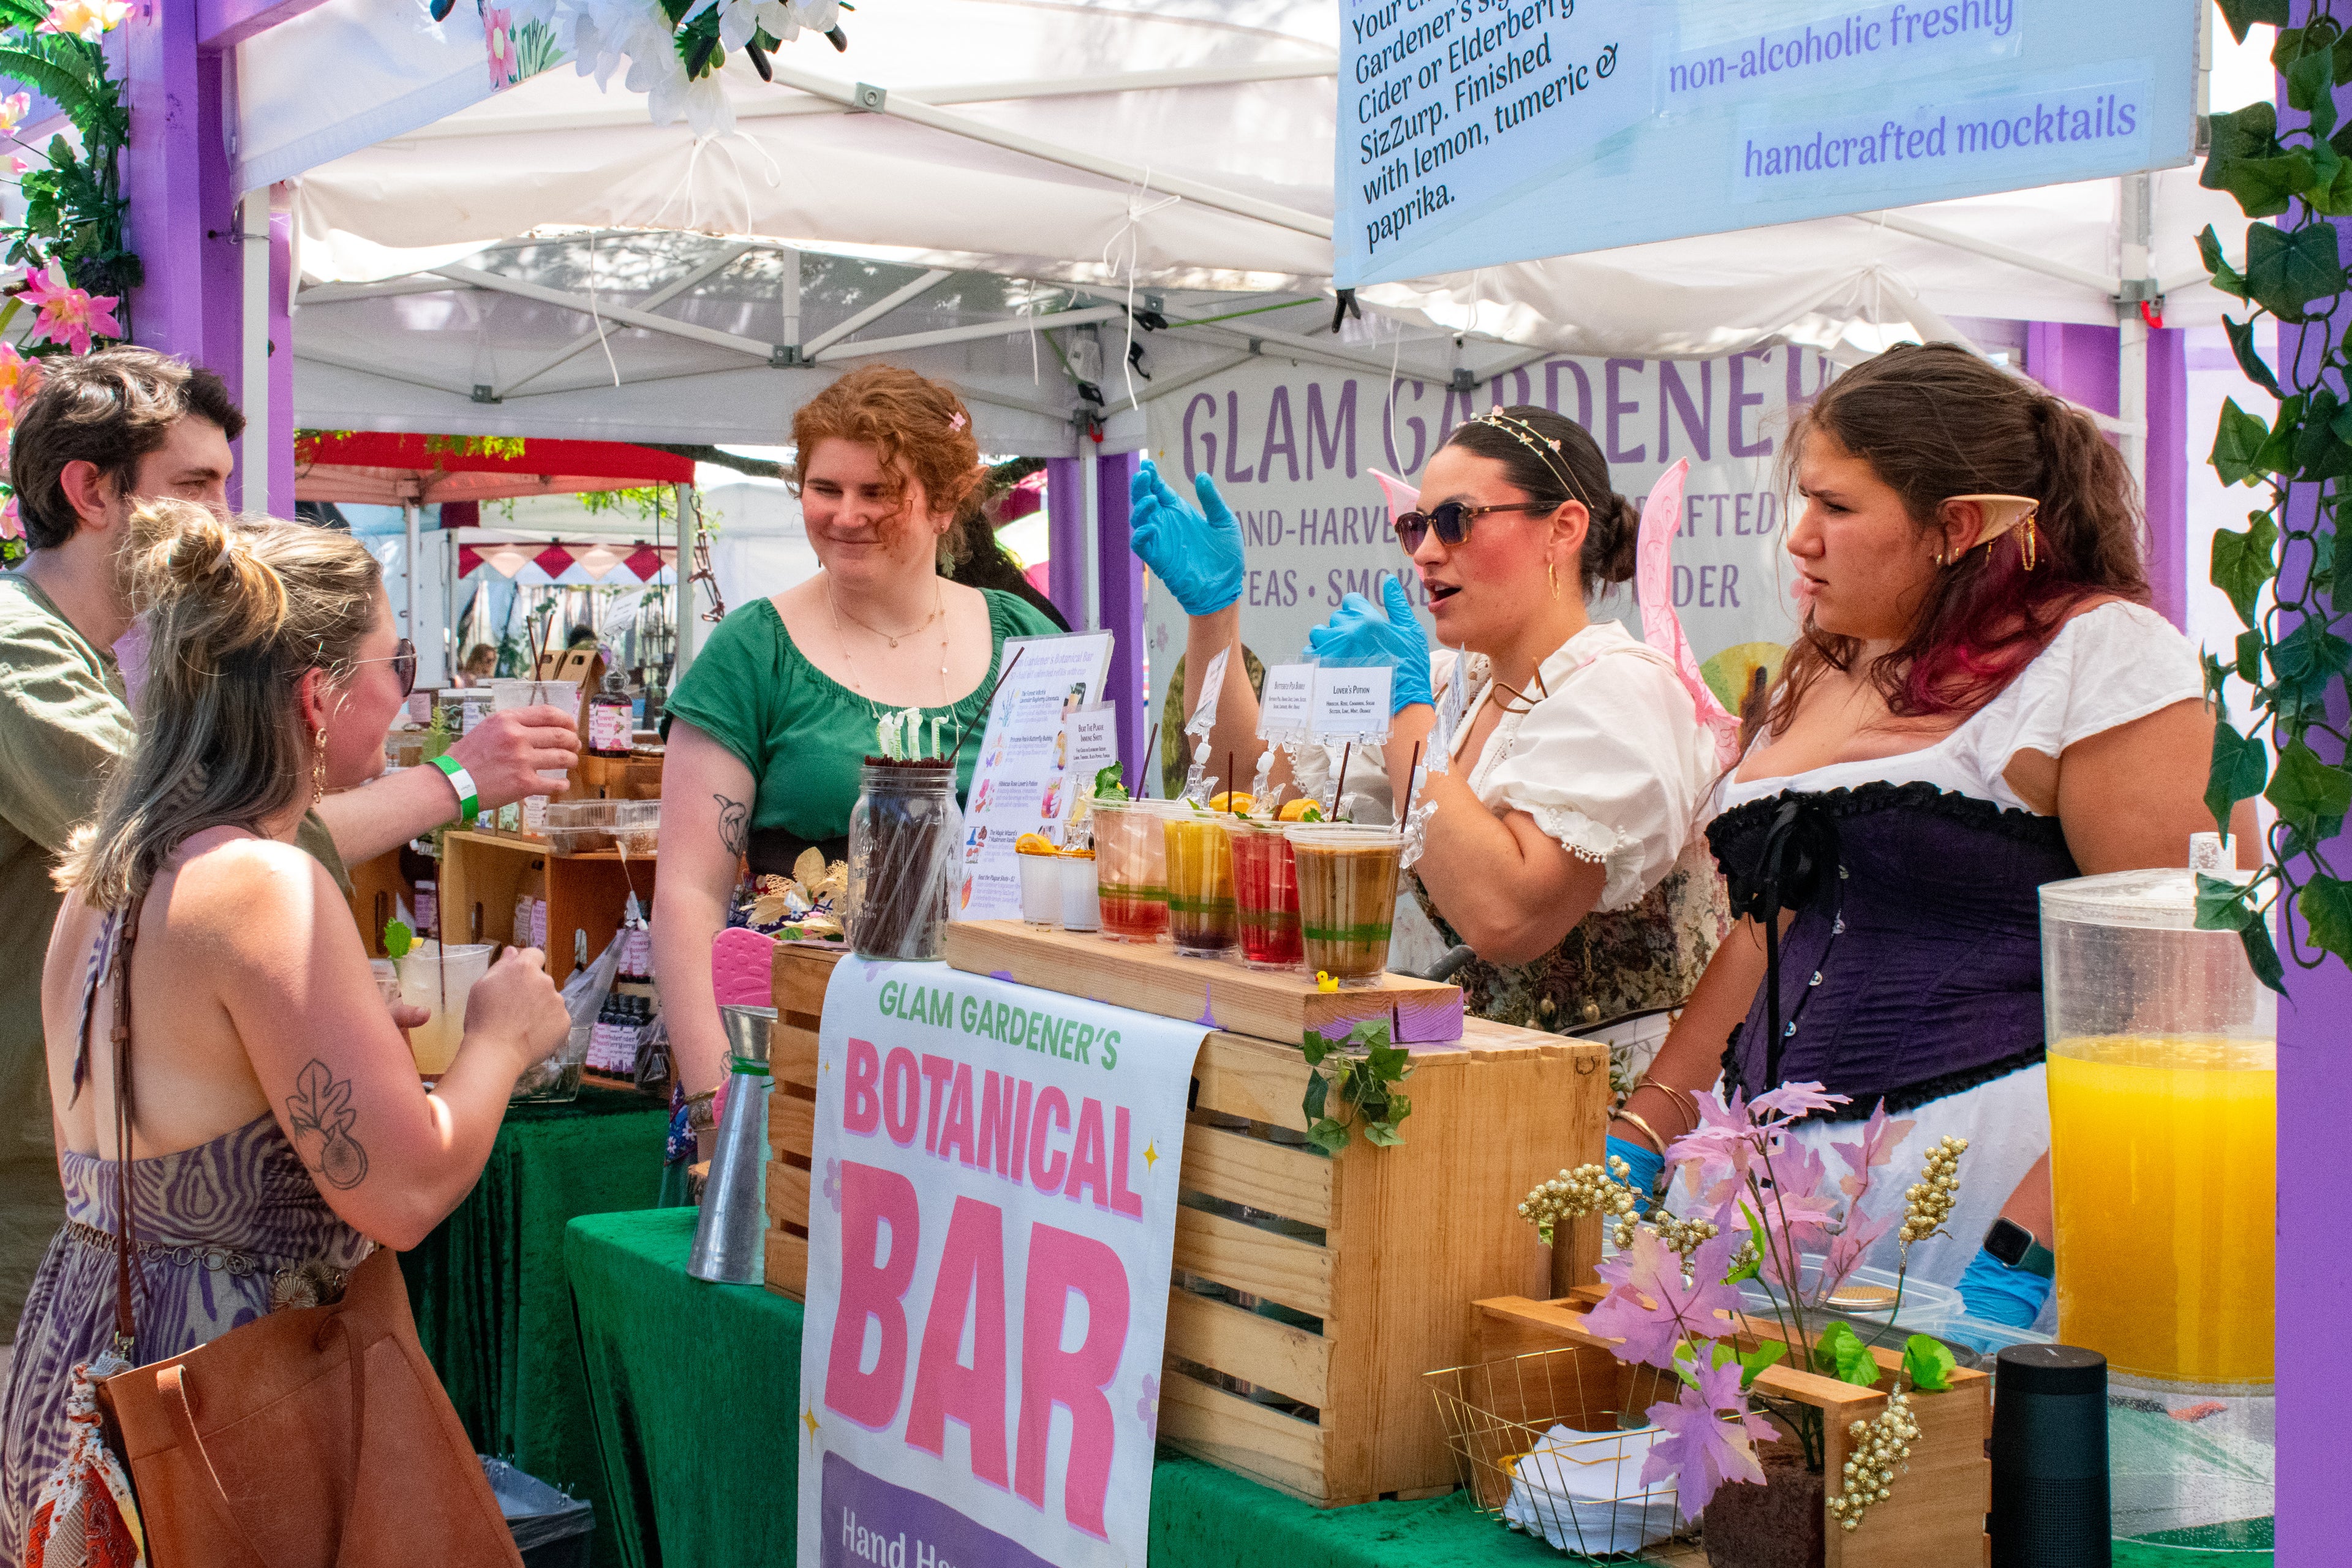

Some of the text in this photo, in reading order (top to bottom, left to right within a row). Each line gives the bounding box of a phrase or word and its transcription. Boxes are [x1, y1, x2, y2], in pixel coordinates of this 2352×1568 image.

[1352, 0, 1401, 45] Your
[1356, 0, 1472, 85] Gardener's
[1359, 0, 1575, 124] Cider or Elderberry
[1669, 0, 2013, 93] non-alcoholic freshly
[1360, 32, 1552, 164] SizZurp. Finished
[1363, 43, 1618, 205] with lemon, tumeric &
[1744, 94, 2136, 178] handcrafted mocktails
[1366, 184, 1455, 254] paprika.
[1182, 378, 1357, 486] GLAM
[880, 979, 1122, 1071] GLAM GARDENER'S
[843, 1036, 1144, 1223] BOTANICAL
[824, 1159, 1132, 1544] BAR
[842, 1506, 905, 1568] Hand
